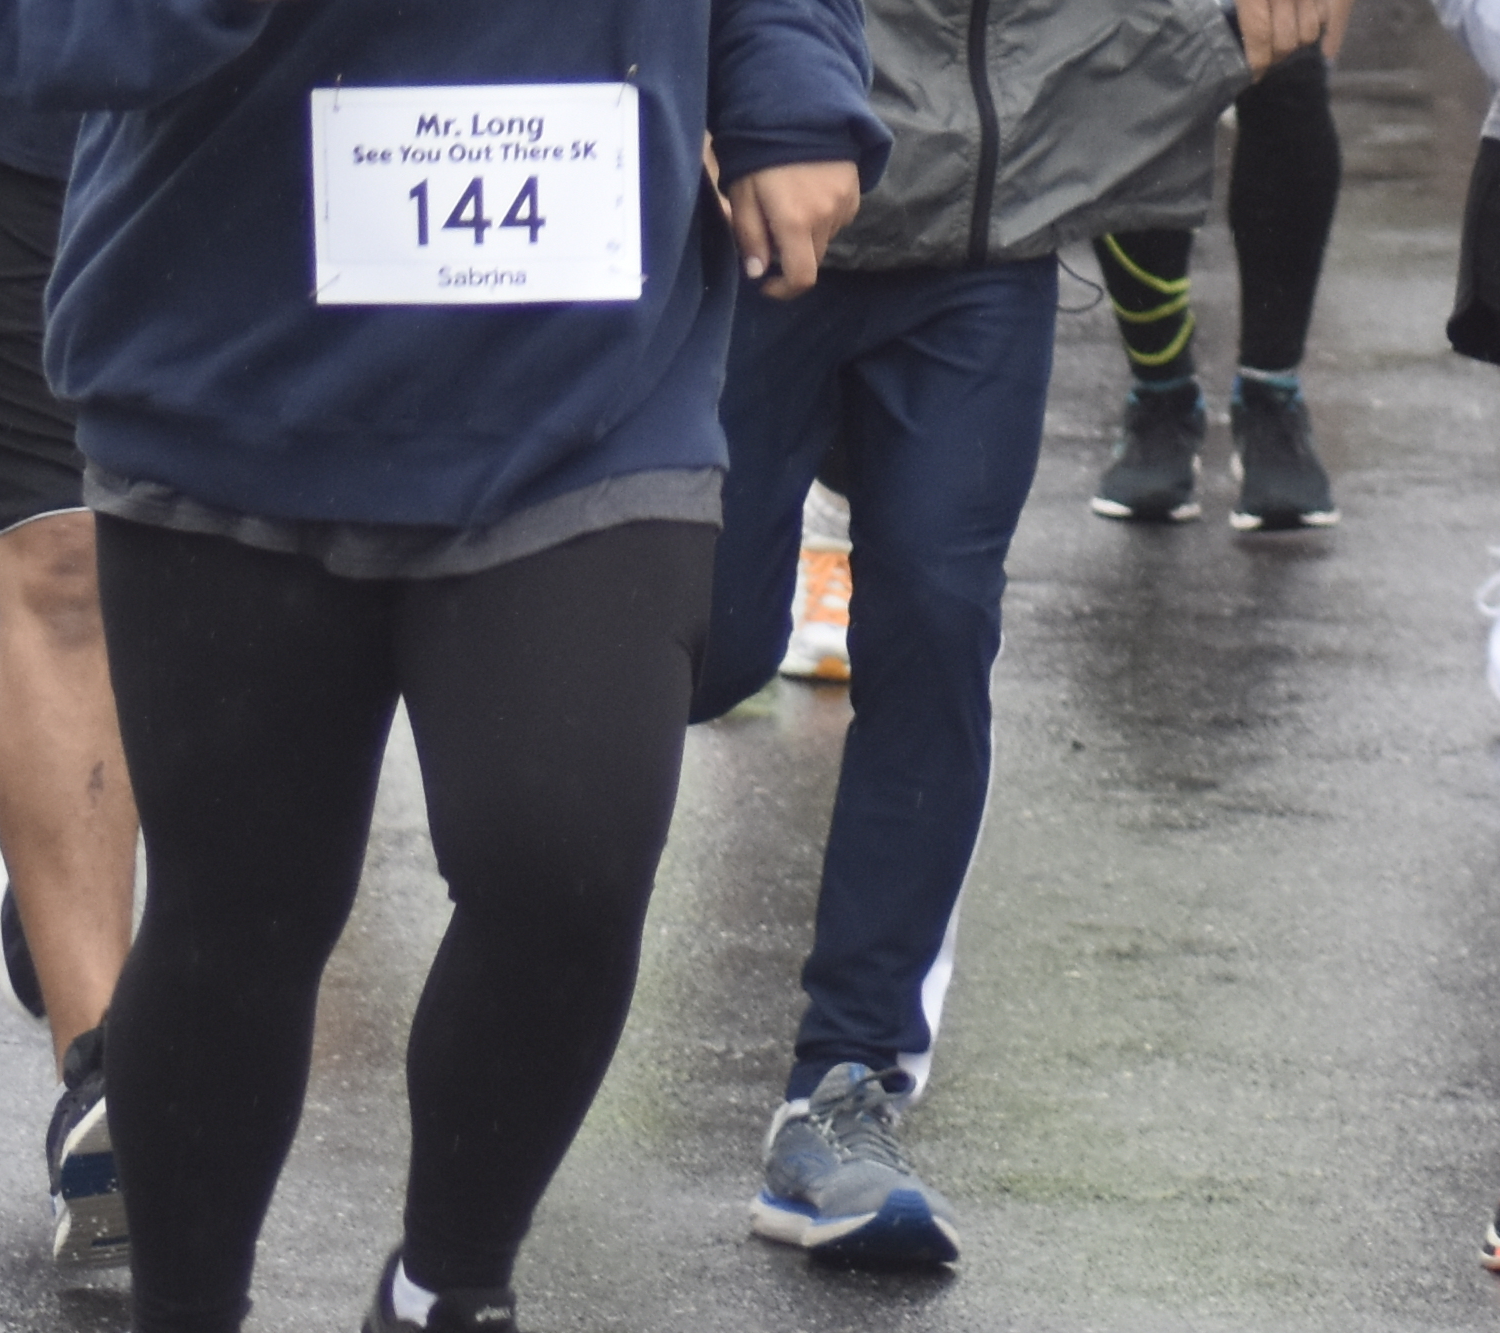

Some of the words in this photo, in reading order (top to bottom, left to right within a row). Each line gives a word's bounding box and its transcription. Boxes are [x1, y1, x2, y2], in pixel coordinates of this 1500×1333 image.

[416, 113, 461, 137] Mr.
[471, 113, 544, 142] Long
[353, 144, 392, 164] See
[400, 144, 441, 163] You
[449, 144, 493, 161] Out
[502, 142, 563, 161] There
[571, 140, 597, 160] 5K
[409, 175, 546, 246] 144
[438, 266, 527, 290] Sabrina
